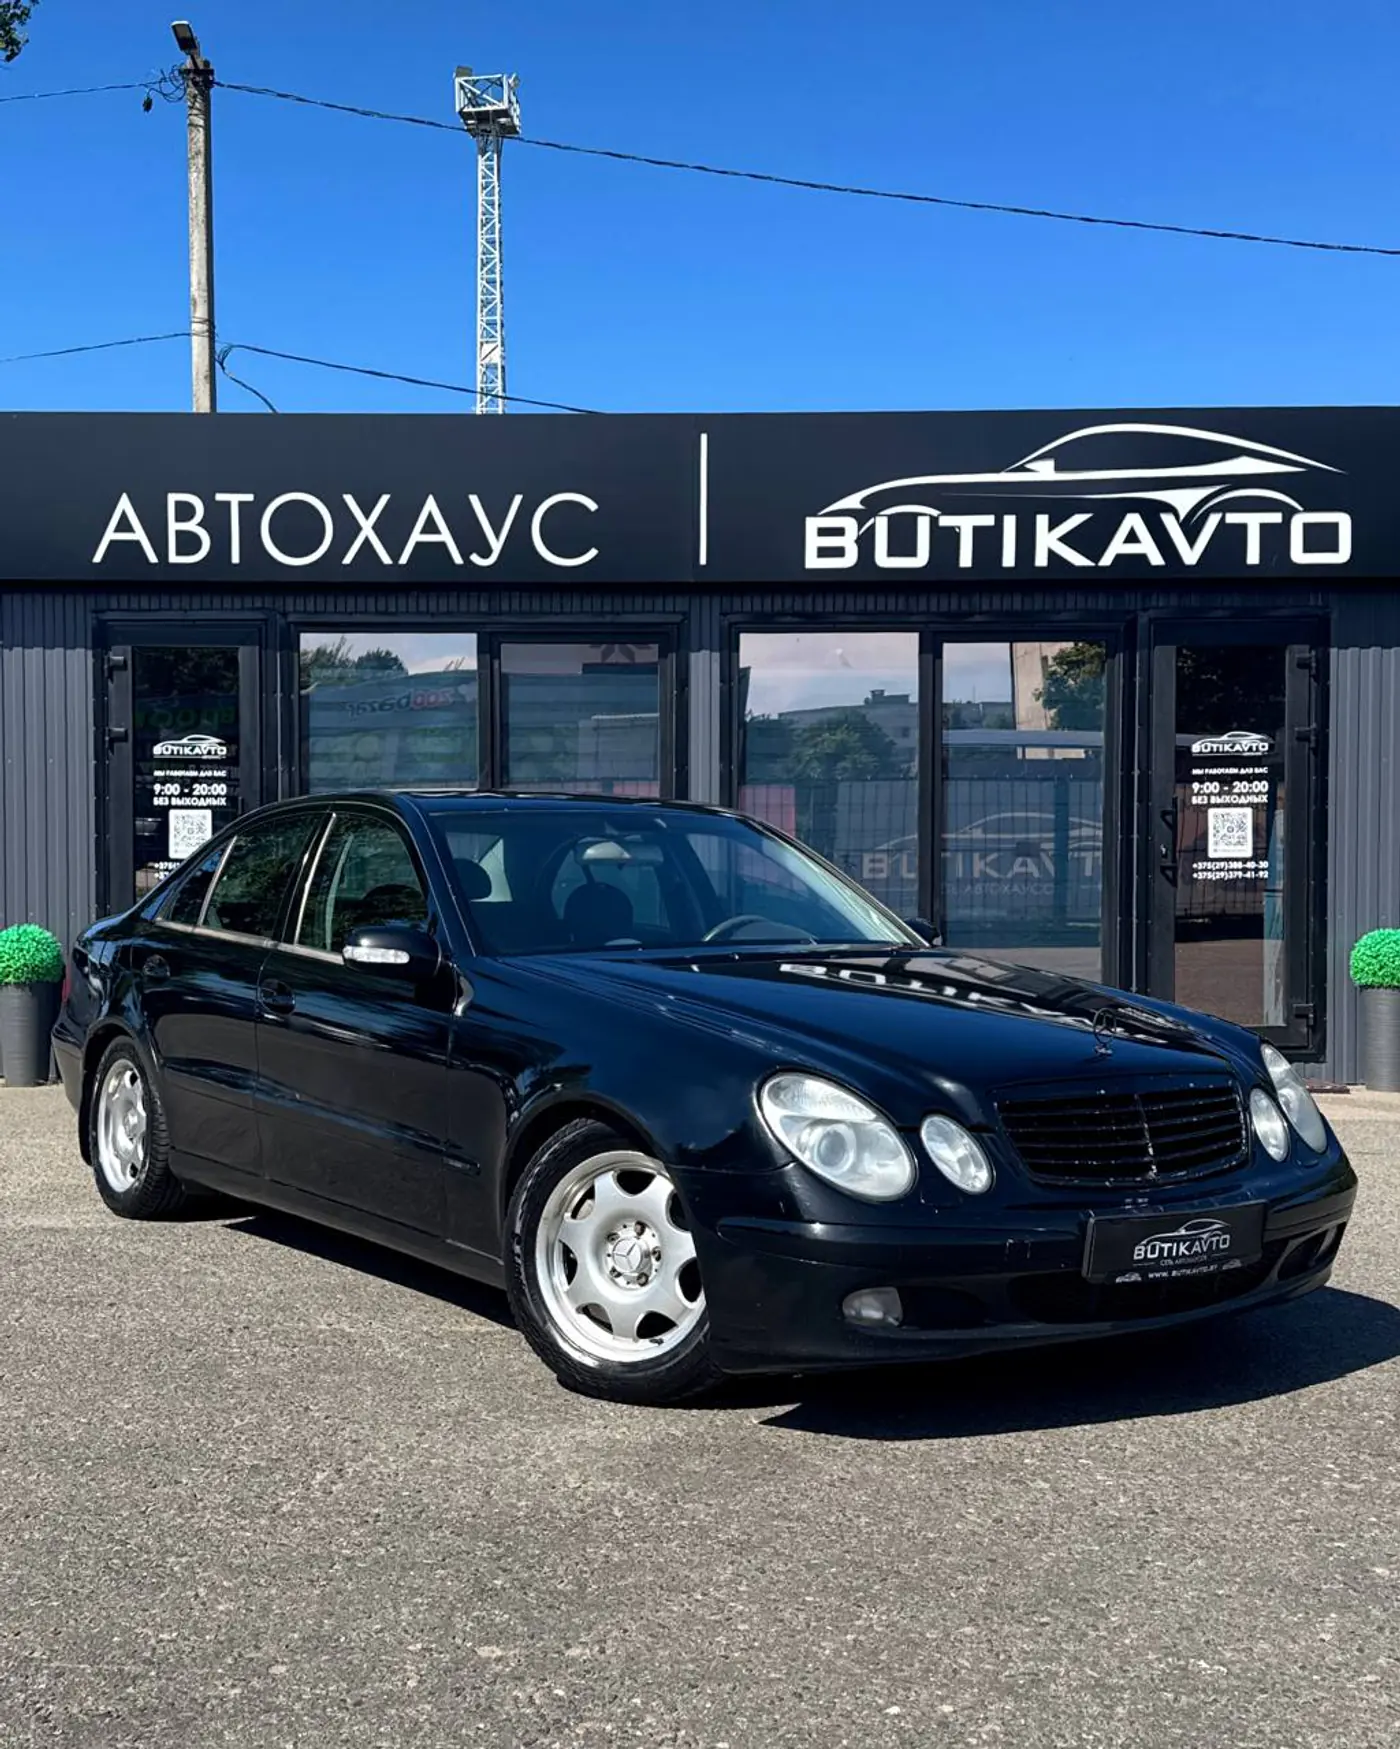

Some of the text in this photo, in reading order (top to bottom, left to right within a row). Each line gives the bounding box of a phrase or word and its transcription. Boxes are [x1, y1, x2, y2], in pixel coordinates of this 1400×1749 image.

[92, 492, 600, 568] АВТОХАУС
[804, 510, 1352, 570] BUTIKAVTO
[153, 745, 227, 755] BUTIKAVTO
[1191, 742, 1269, 753] BUTIKAVTO
[153, 783, 181, 796] 9:00
[192, 783, 227, 796] 20:00
[1192, 781, 1220, 794] 9:00
[1232, 780, 1269, 793] 20:00
[153, 796, 227, 807] БЕЗ ВЫХОДНЫХ
[1191, 794, 1268, 805] БЕЗ ВЫХОДНЫХ
[1133, 1234, 1231, 1261] BUTIKAVTO
